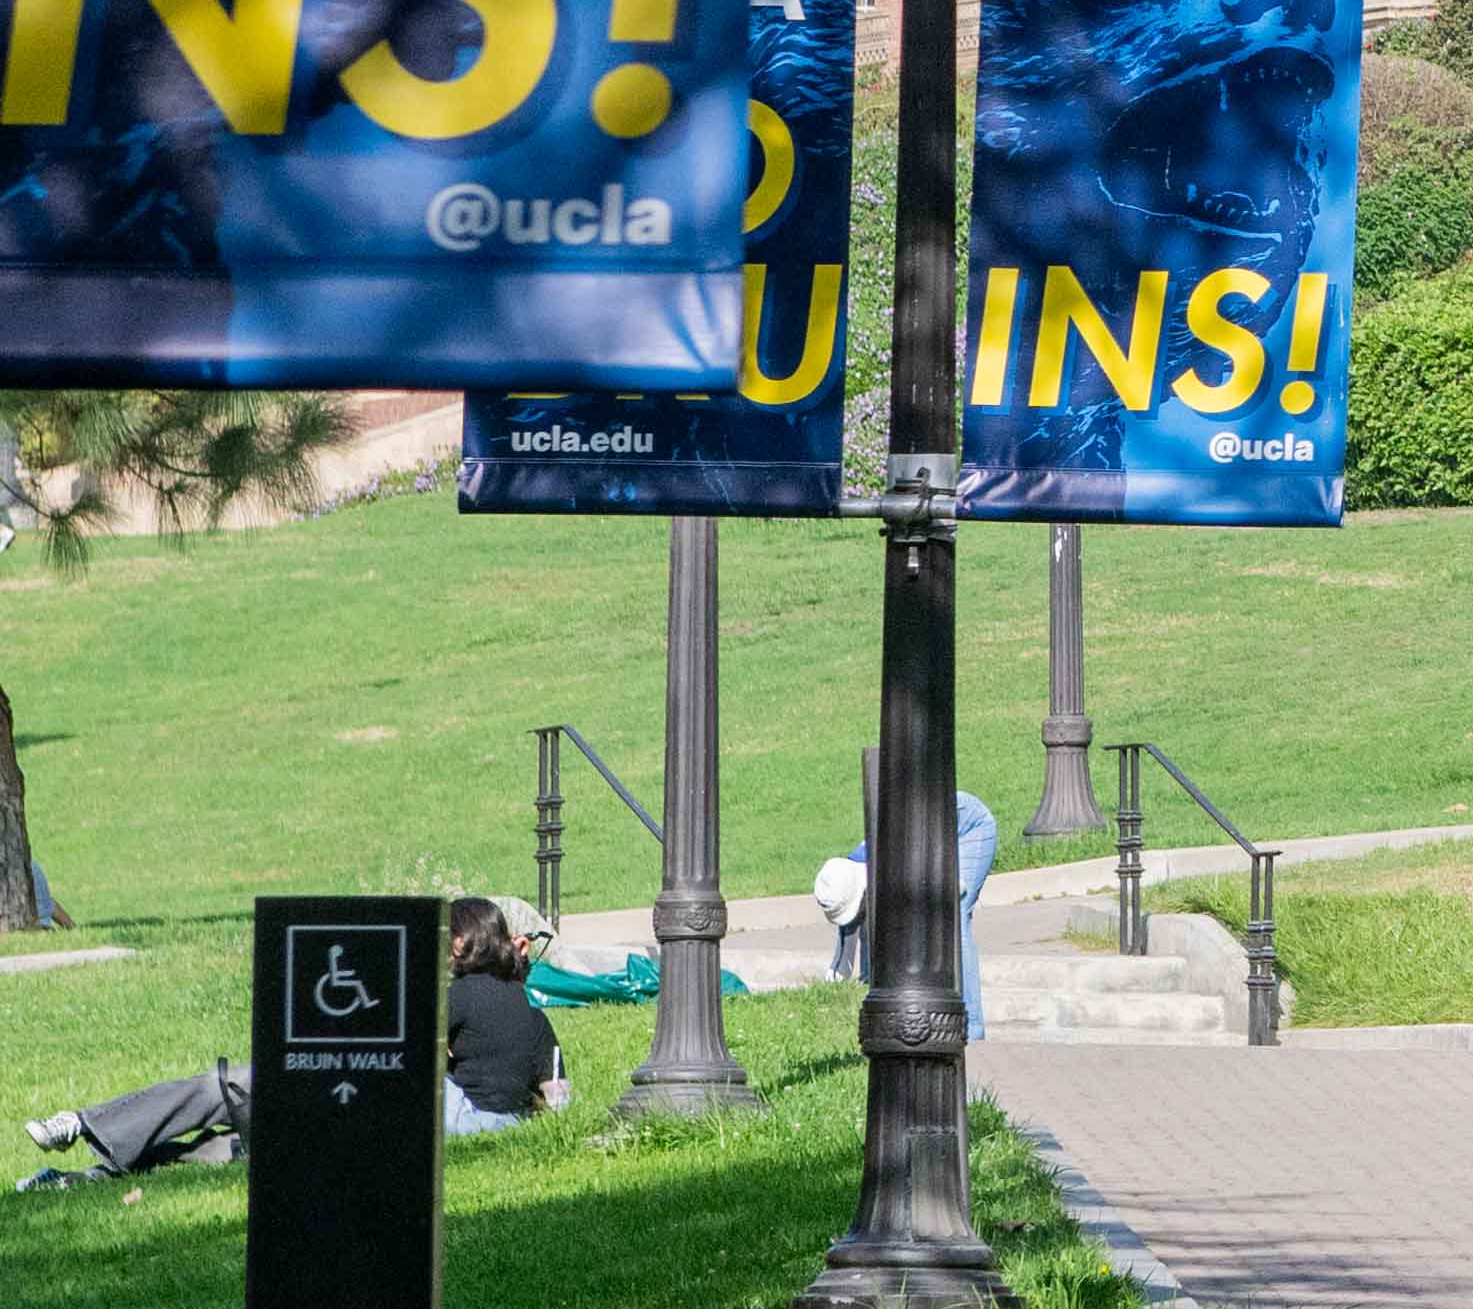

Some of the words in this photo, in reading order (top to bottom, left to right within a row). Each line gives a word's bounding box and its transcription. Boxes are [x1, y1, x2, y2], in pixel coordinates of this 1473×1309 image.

[426, 181, 673, 251] @ucla
[970, 264, 1329, 415] INS!
[510, 424, 655, 454] ucla.edu
[1208, 431, 1315, 465] @ucla
[285, 1051, 344, 1070] BRUIN
[347, 1051, 405, 1070] WALK
